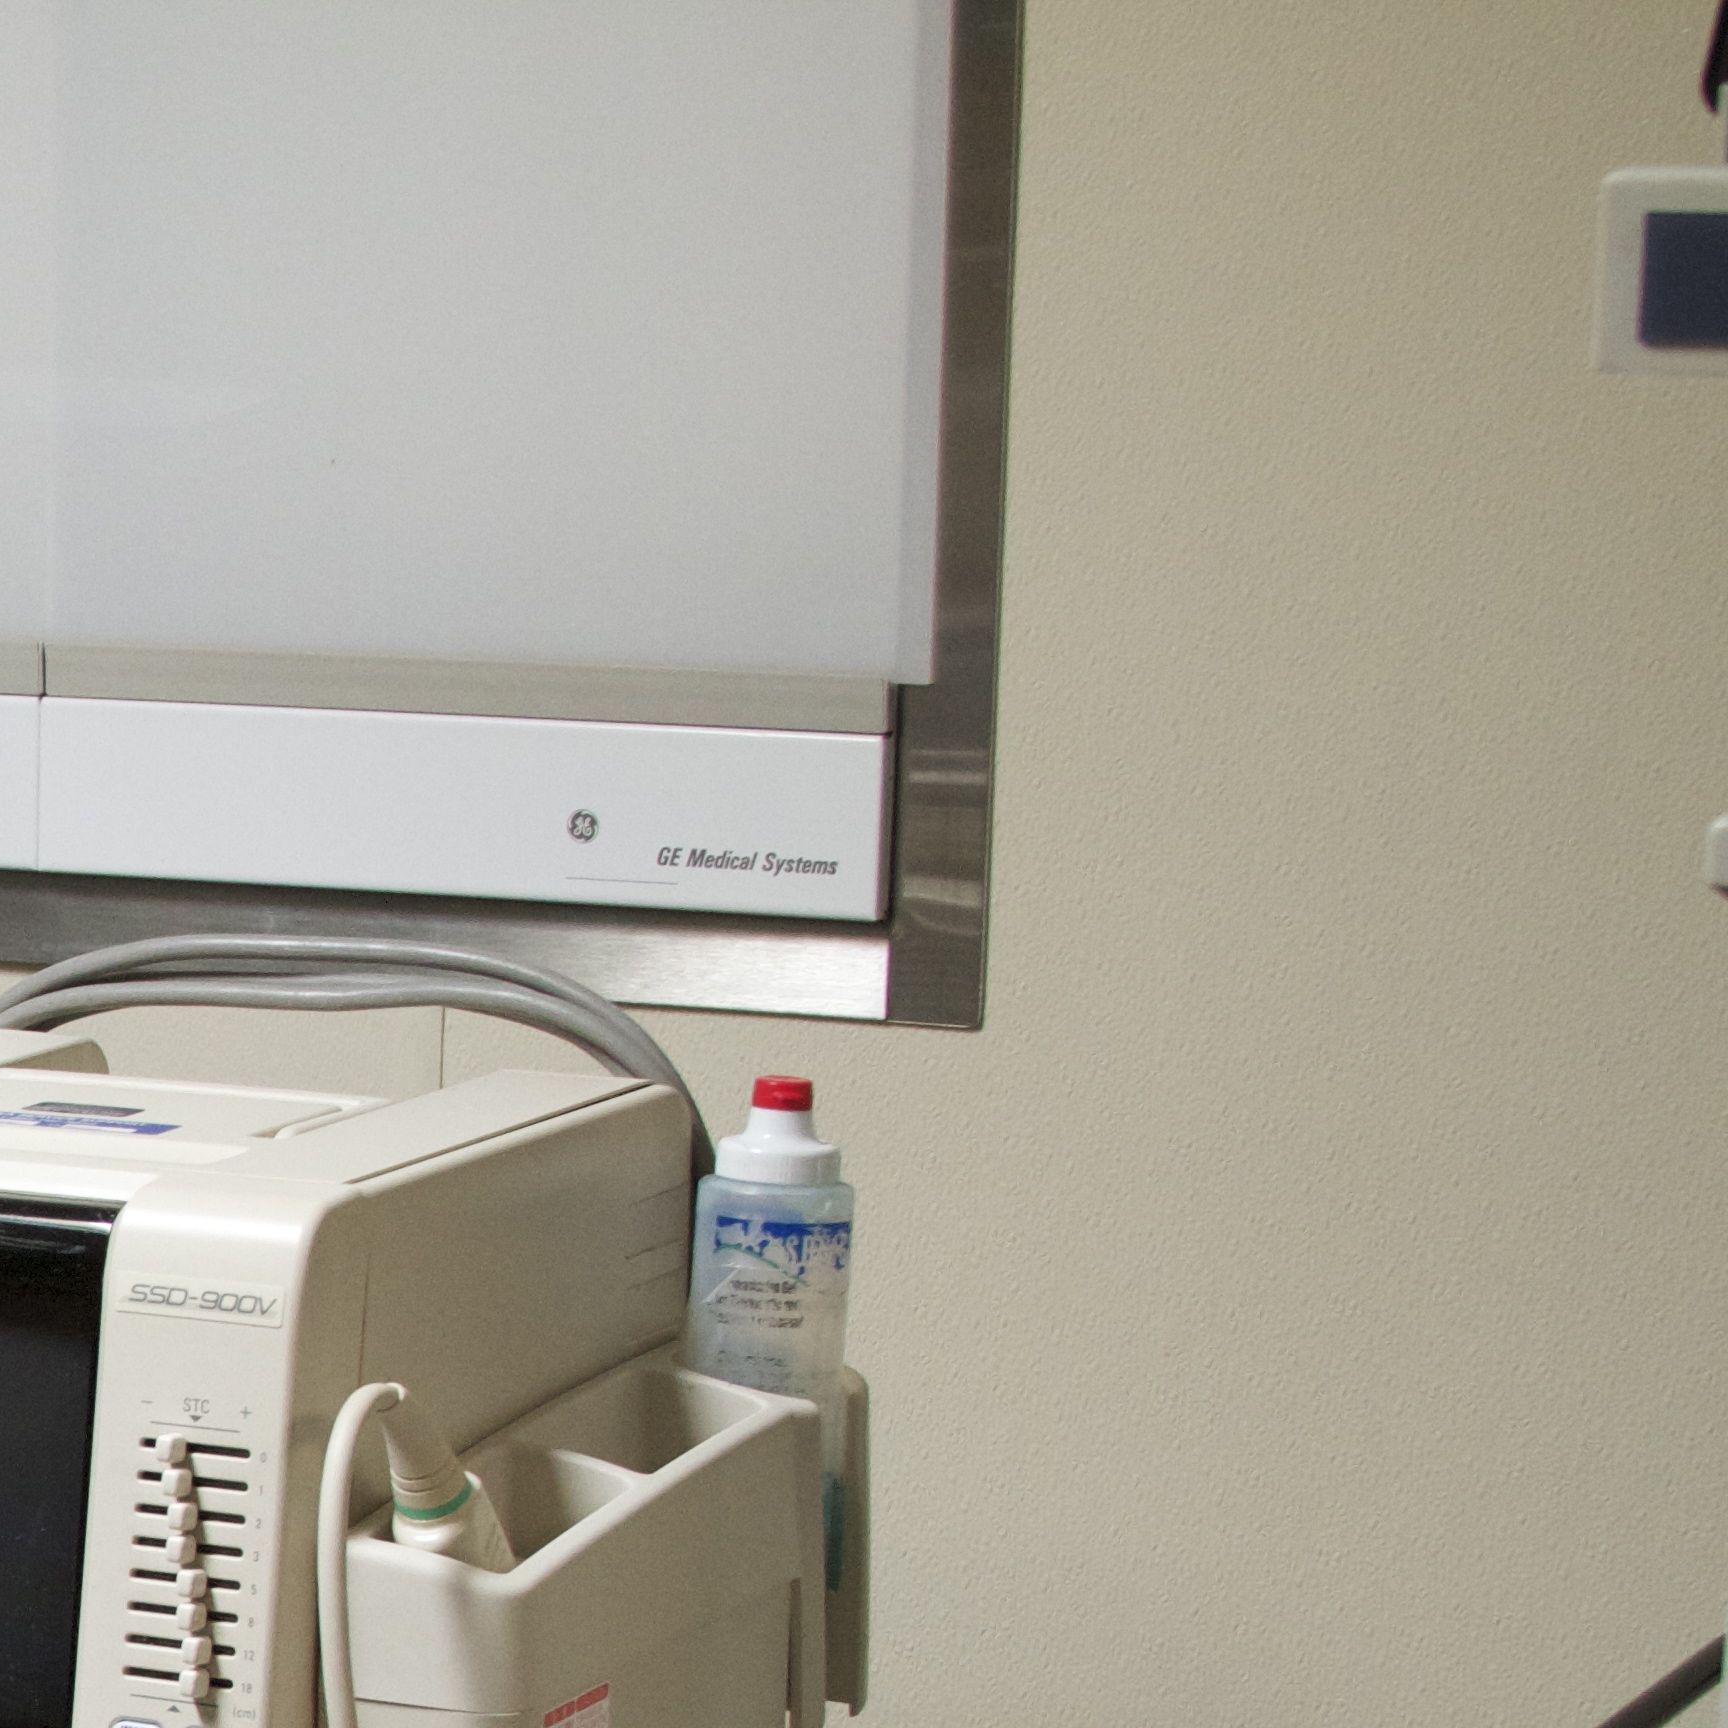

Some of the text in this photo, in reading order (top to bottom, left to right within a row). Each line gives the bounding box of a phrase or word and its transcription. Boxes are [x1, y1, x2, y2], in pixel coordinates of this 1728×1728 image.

[657, 847, 839, 877] GE Medical Systems
[128, 1284, 278, 1315] SSD-900V
[182, 1397, 210, 1415] STC
[255, 1518, 263, 1530] 2
[253, 1551, 260, 1563] 3
[251, 1584, 257, 1596] 5
[244, 1650, 255, 1662] 12
